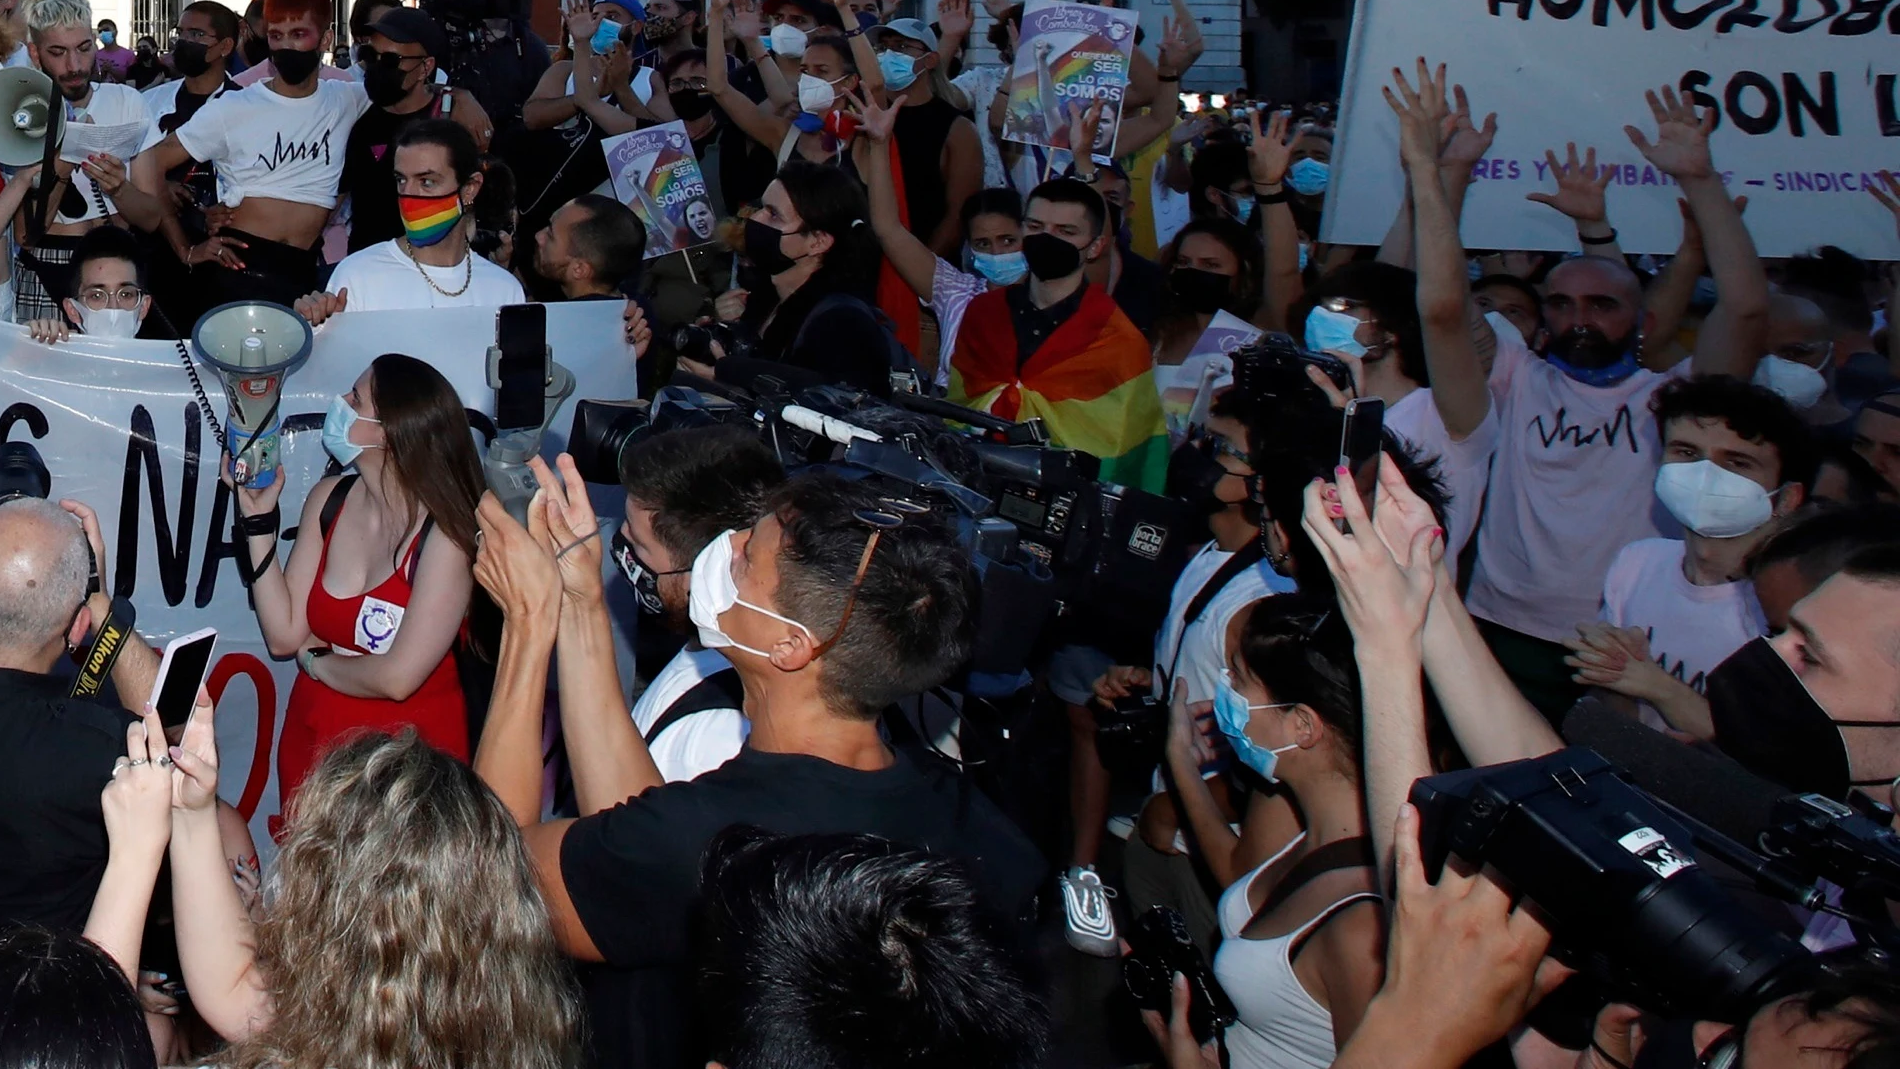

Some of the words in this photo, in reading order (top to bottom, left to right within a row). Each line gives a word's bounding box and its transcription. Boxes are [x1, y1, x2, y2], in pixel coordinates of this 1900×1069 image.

[1071, 50, 1123, 63] QUEREMOS
[1093, 60, 1122, 73] SER
[1079, 74, 1093, 84] LO
[1097, 76, 1121, 86] QUE
[1054, 83, 1121, 102] SOMOS
[1680, 69, 1841, 137] SON
[655, 157, 692, 174] QUEREMOS
[673, 164, 696, 179] SER
[668, 181, 681, 192] LO
[681, 176, 699, 187] QUE
[655, 184, 705, 208] SOMOS
[1132, 538, 1159, 554] brace
[1135, 531, 1162, 545] porta
[89, 625, 120, 674] Nikon
